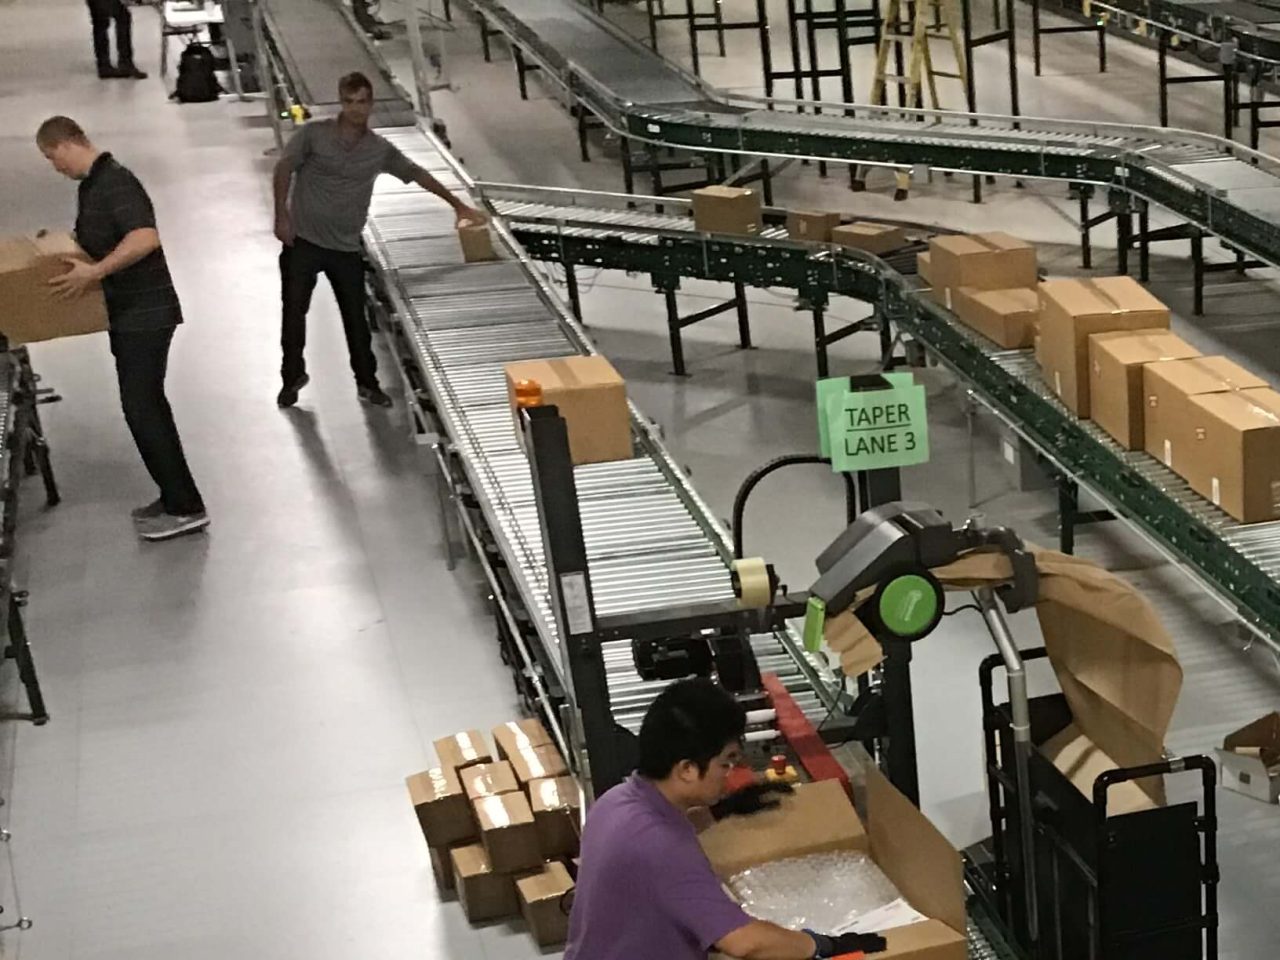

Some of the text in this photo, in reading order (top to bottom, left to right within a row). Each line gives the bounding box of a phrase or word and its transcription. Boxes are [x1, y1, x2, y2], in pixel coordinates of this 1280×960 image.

[844, 403, 911, 427] TAPER
[844, 431, 916, 456] LANE 3
